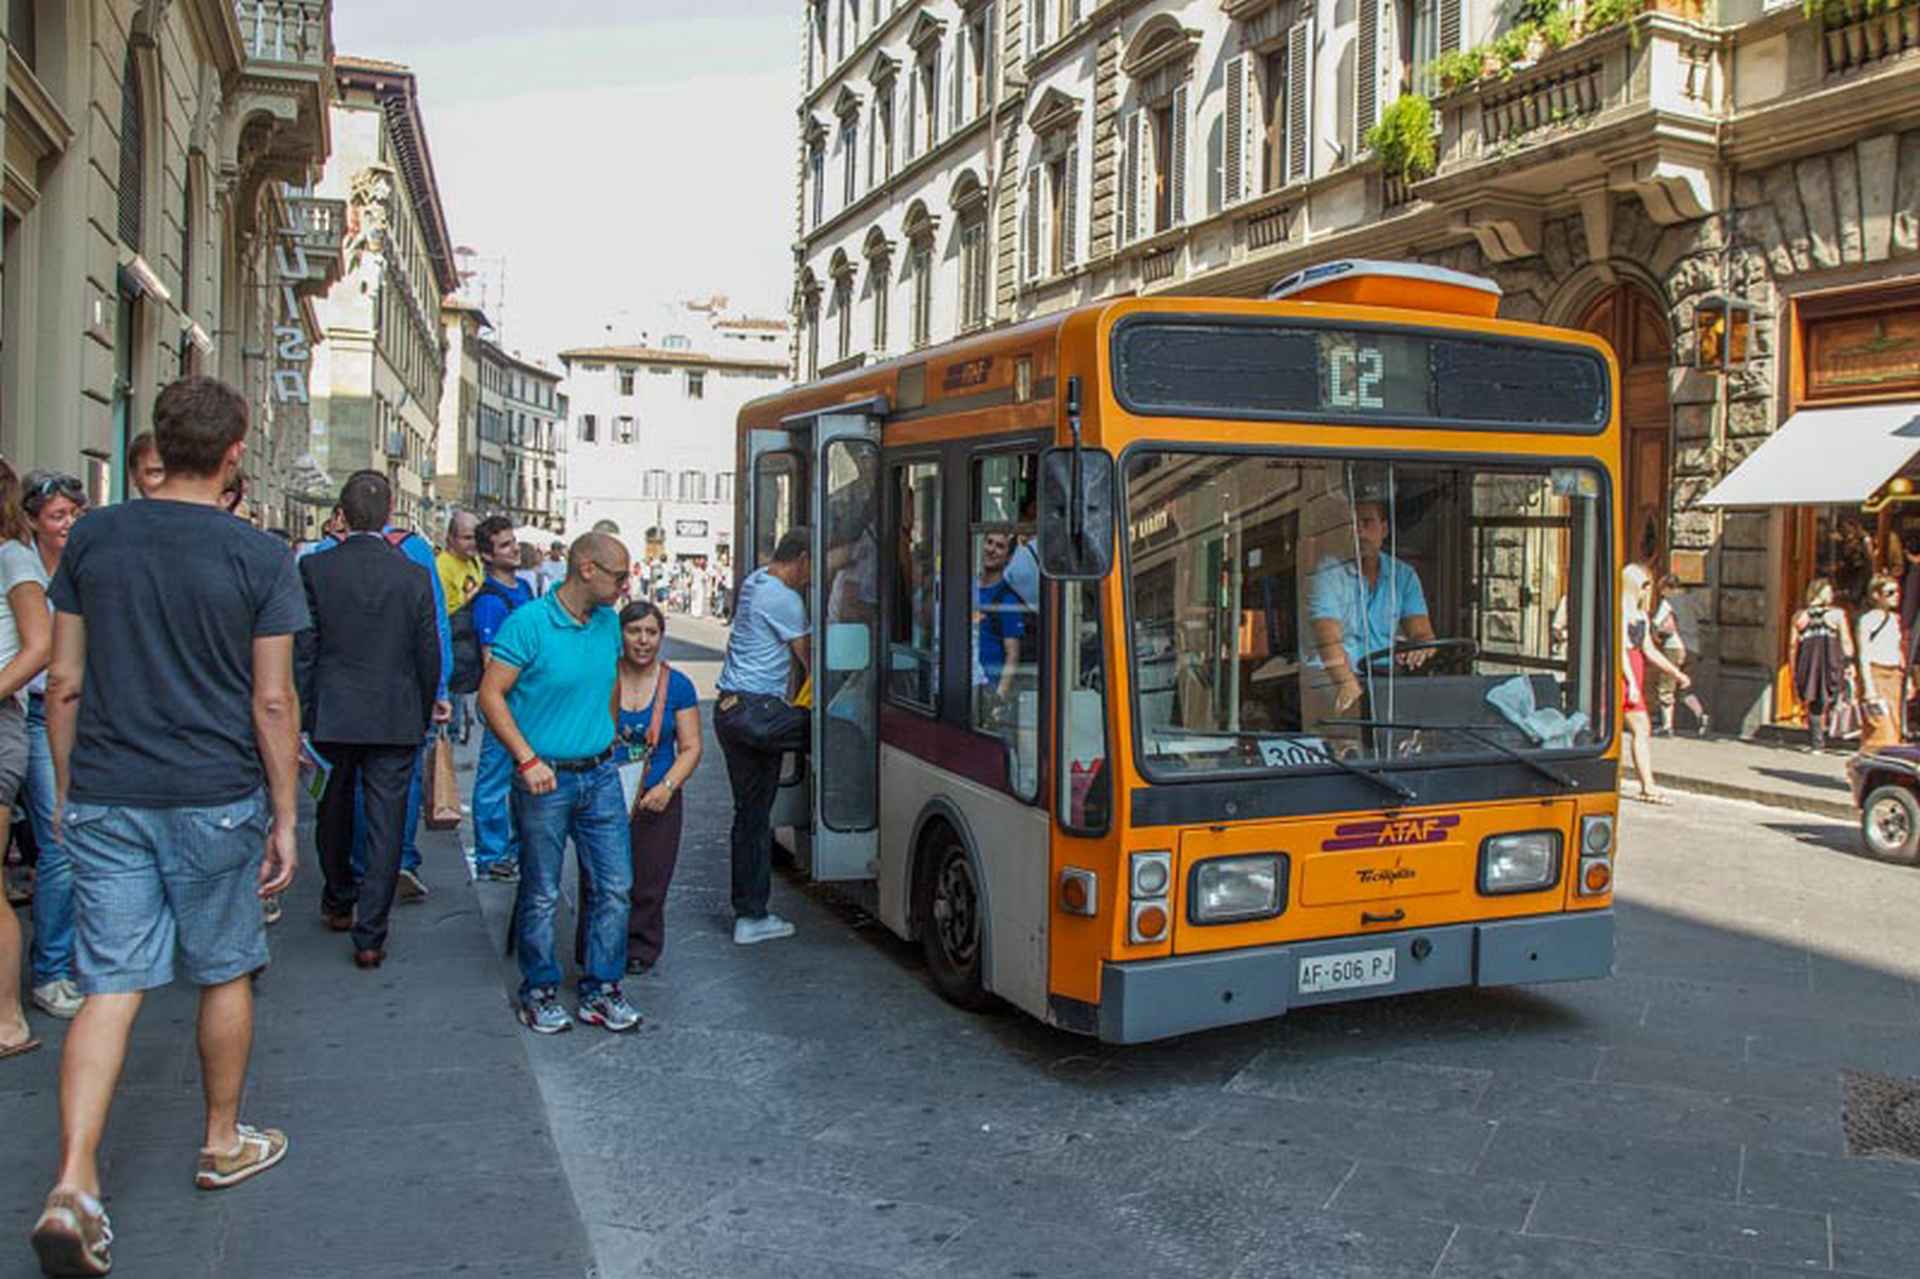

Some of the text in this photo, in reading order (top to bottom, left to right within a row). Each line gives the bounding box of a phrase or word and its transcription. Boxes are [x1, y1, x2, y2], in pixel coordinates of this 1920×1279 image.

[1329, 345, 1384, 409] C2
[1377, 819, 1440, 845] ATAF
[1371, 953, 1394, 978] PJ
